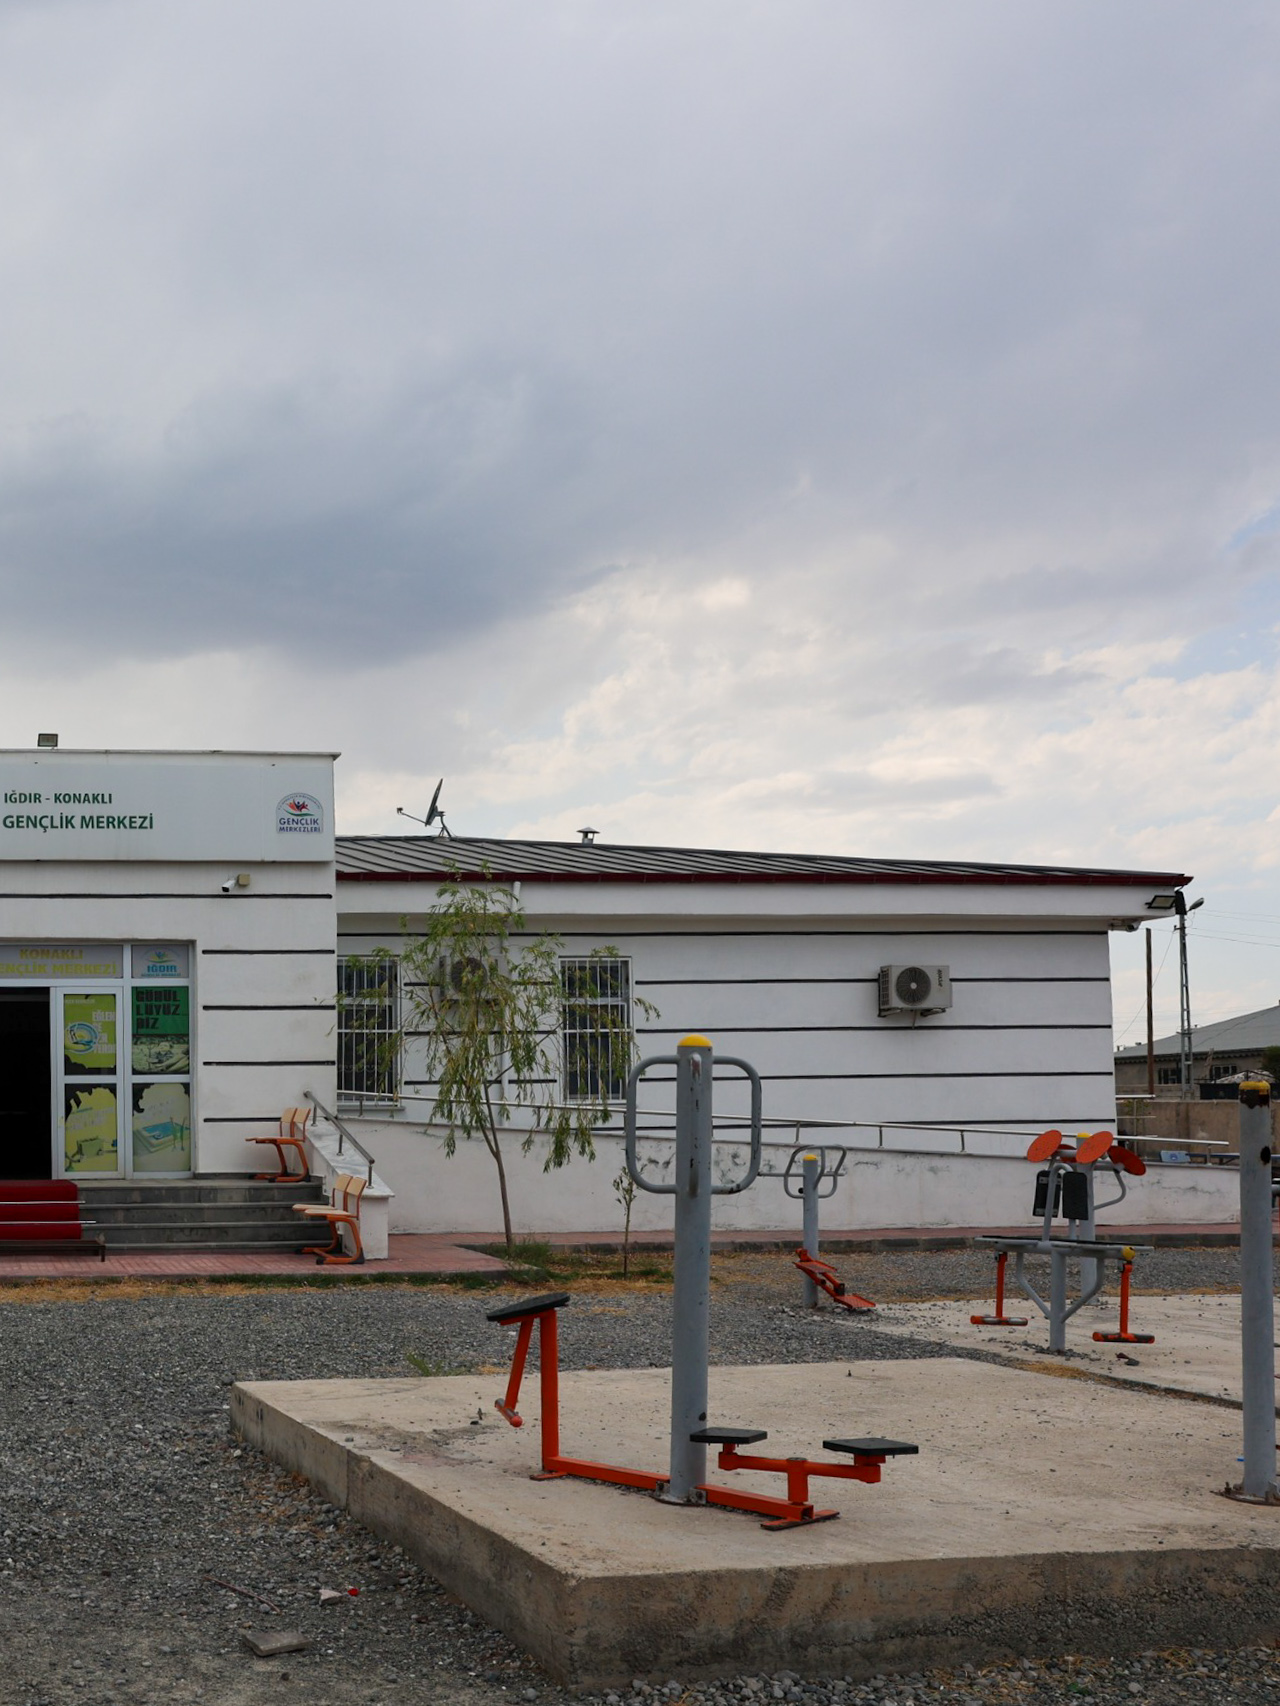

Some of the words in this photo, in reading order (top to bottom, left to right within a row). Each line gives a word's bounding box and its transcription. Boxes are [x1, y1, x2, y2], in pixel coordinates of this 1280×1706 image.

[4, 790, 43, 804] IĞDIR
[54, 792, 113, 804] KONAKLI
[2, 811, 76, 834] GENÇLİK
[80, 812, 154, 830] MERKEZİ
[19, 948, 84, 960] KONAKLI
[52, 961, 117, 974] MERKEZİ
